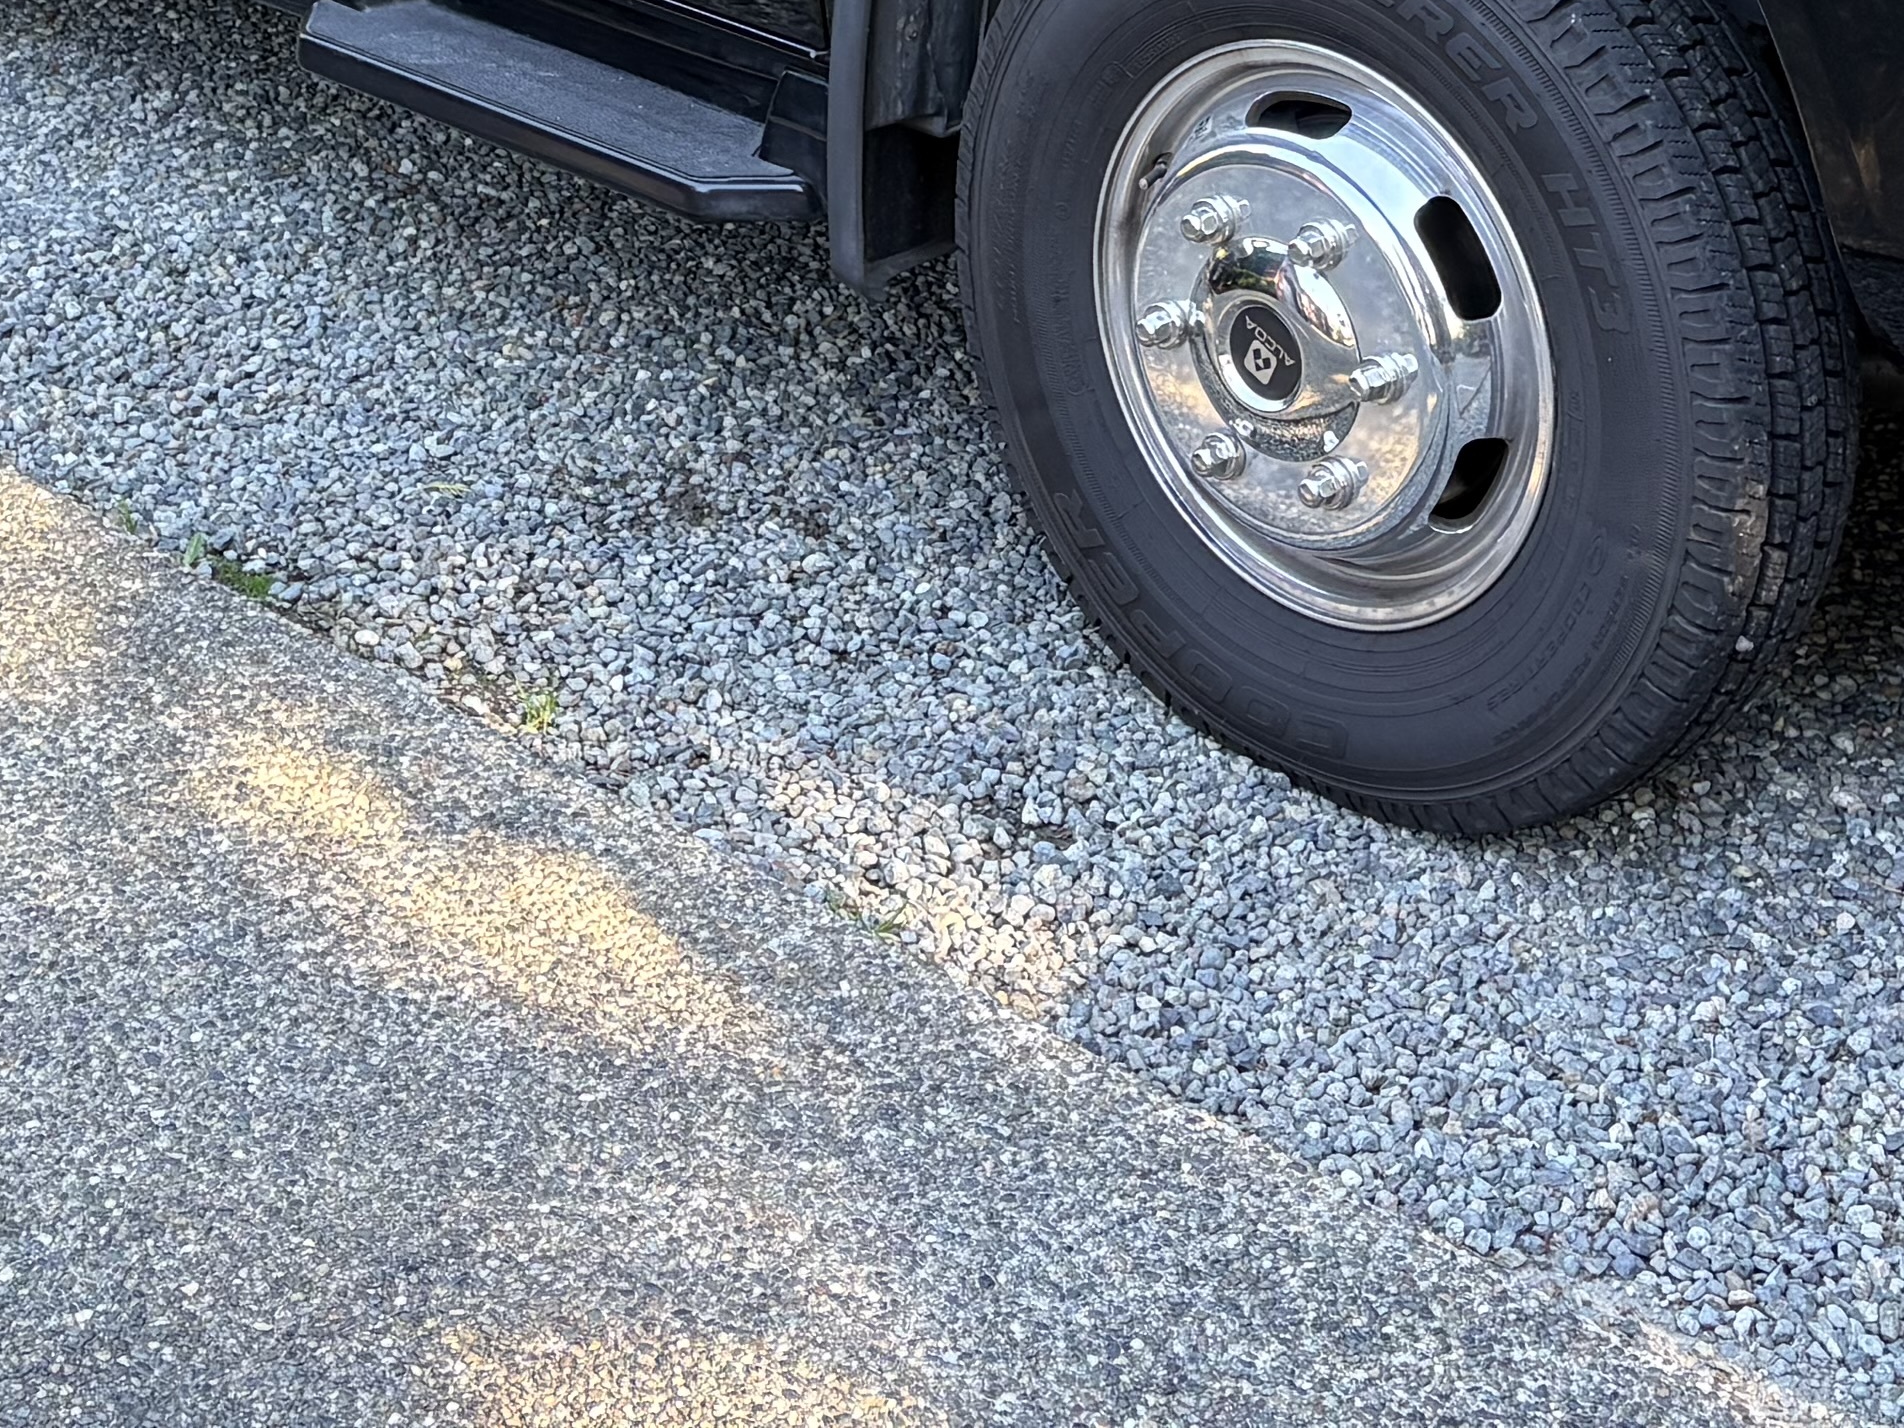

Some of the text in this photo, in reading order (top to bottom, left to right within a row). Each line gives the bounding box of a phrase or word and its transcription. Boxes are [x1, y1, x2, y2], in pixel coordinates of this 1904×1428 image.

[1542, 173, 1631, 335] HT3
[1245, 315, 1296, 366] ALCOA
[1053, 491, 1349, 759] COOPER
